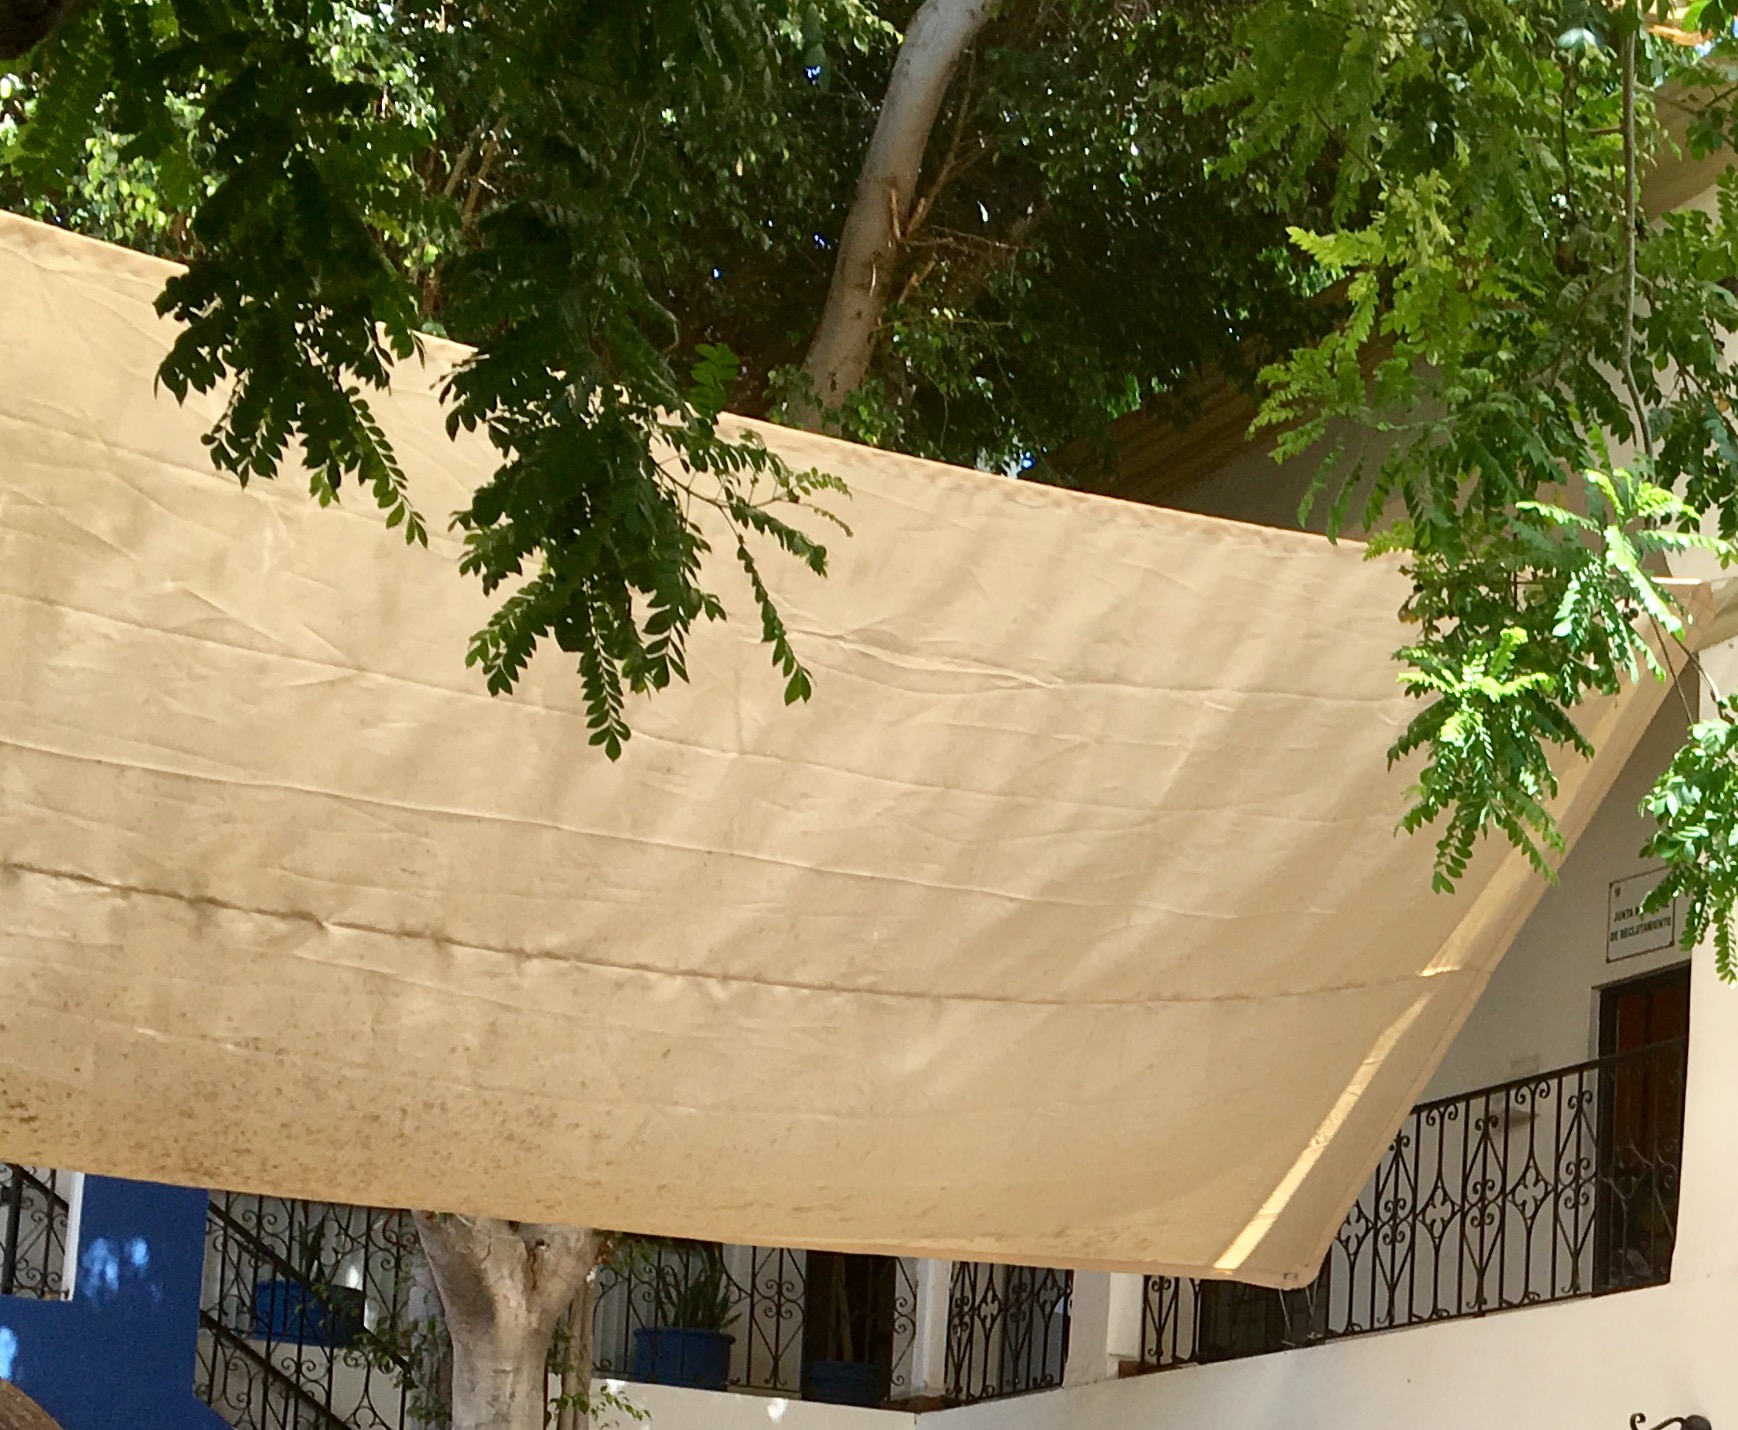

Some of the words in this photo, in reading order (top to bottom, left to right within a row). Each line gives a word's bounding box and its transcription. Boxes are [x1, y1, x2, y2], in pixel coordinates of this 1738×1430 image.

[1613, 908, 1634, 922] JUNTA
[1610, 931, 1619, 942] DE
[1620, 916, 1671, 939] RECLUTAMIENTO
